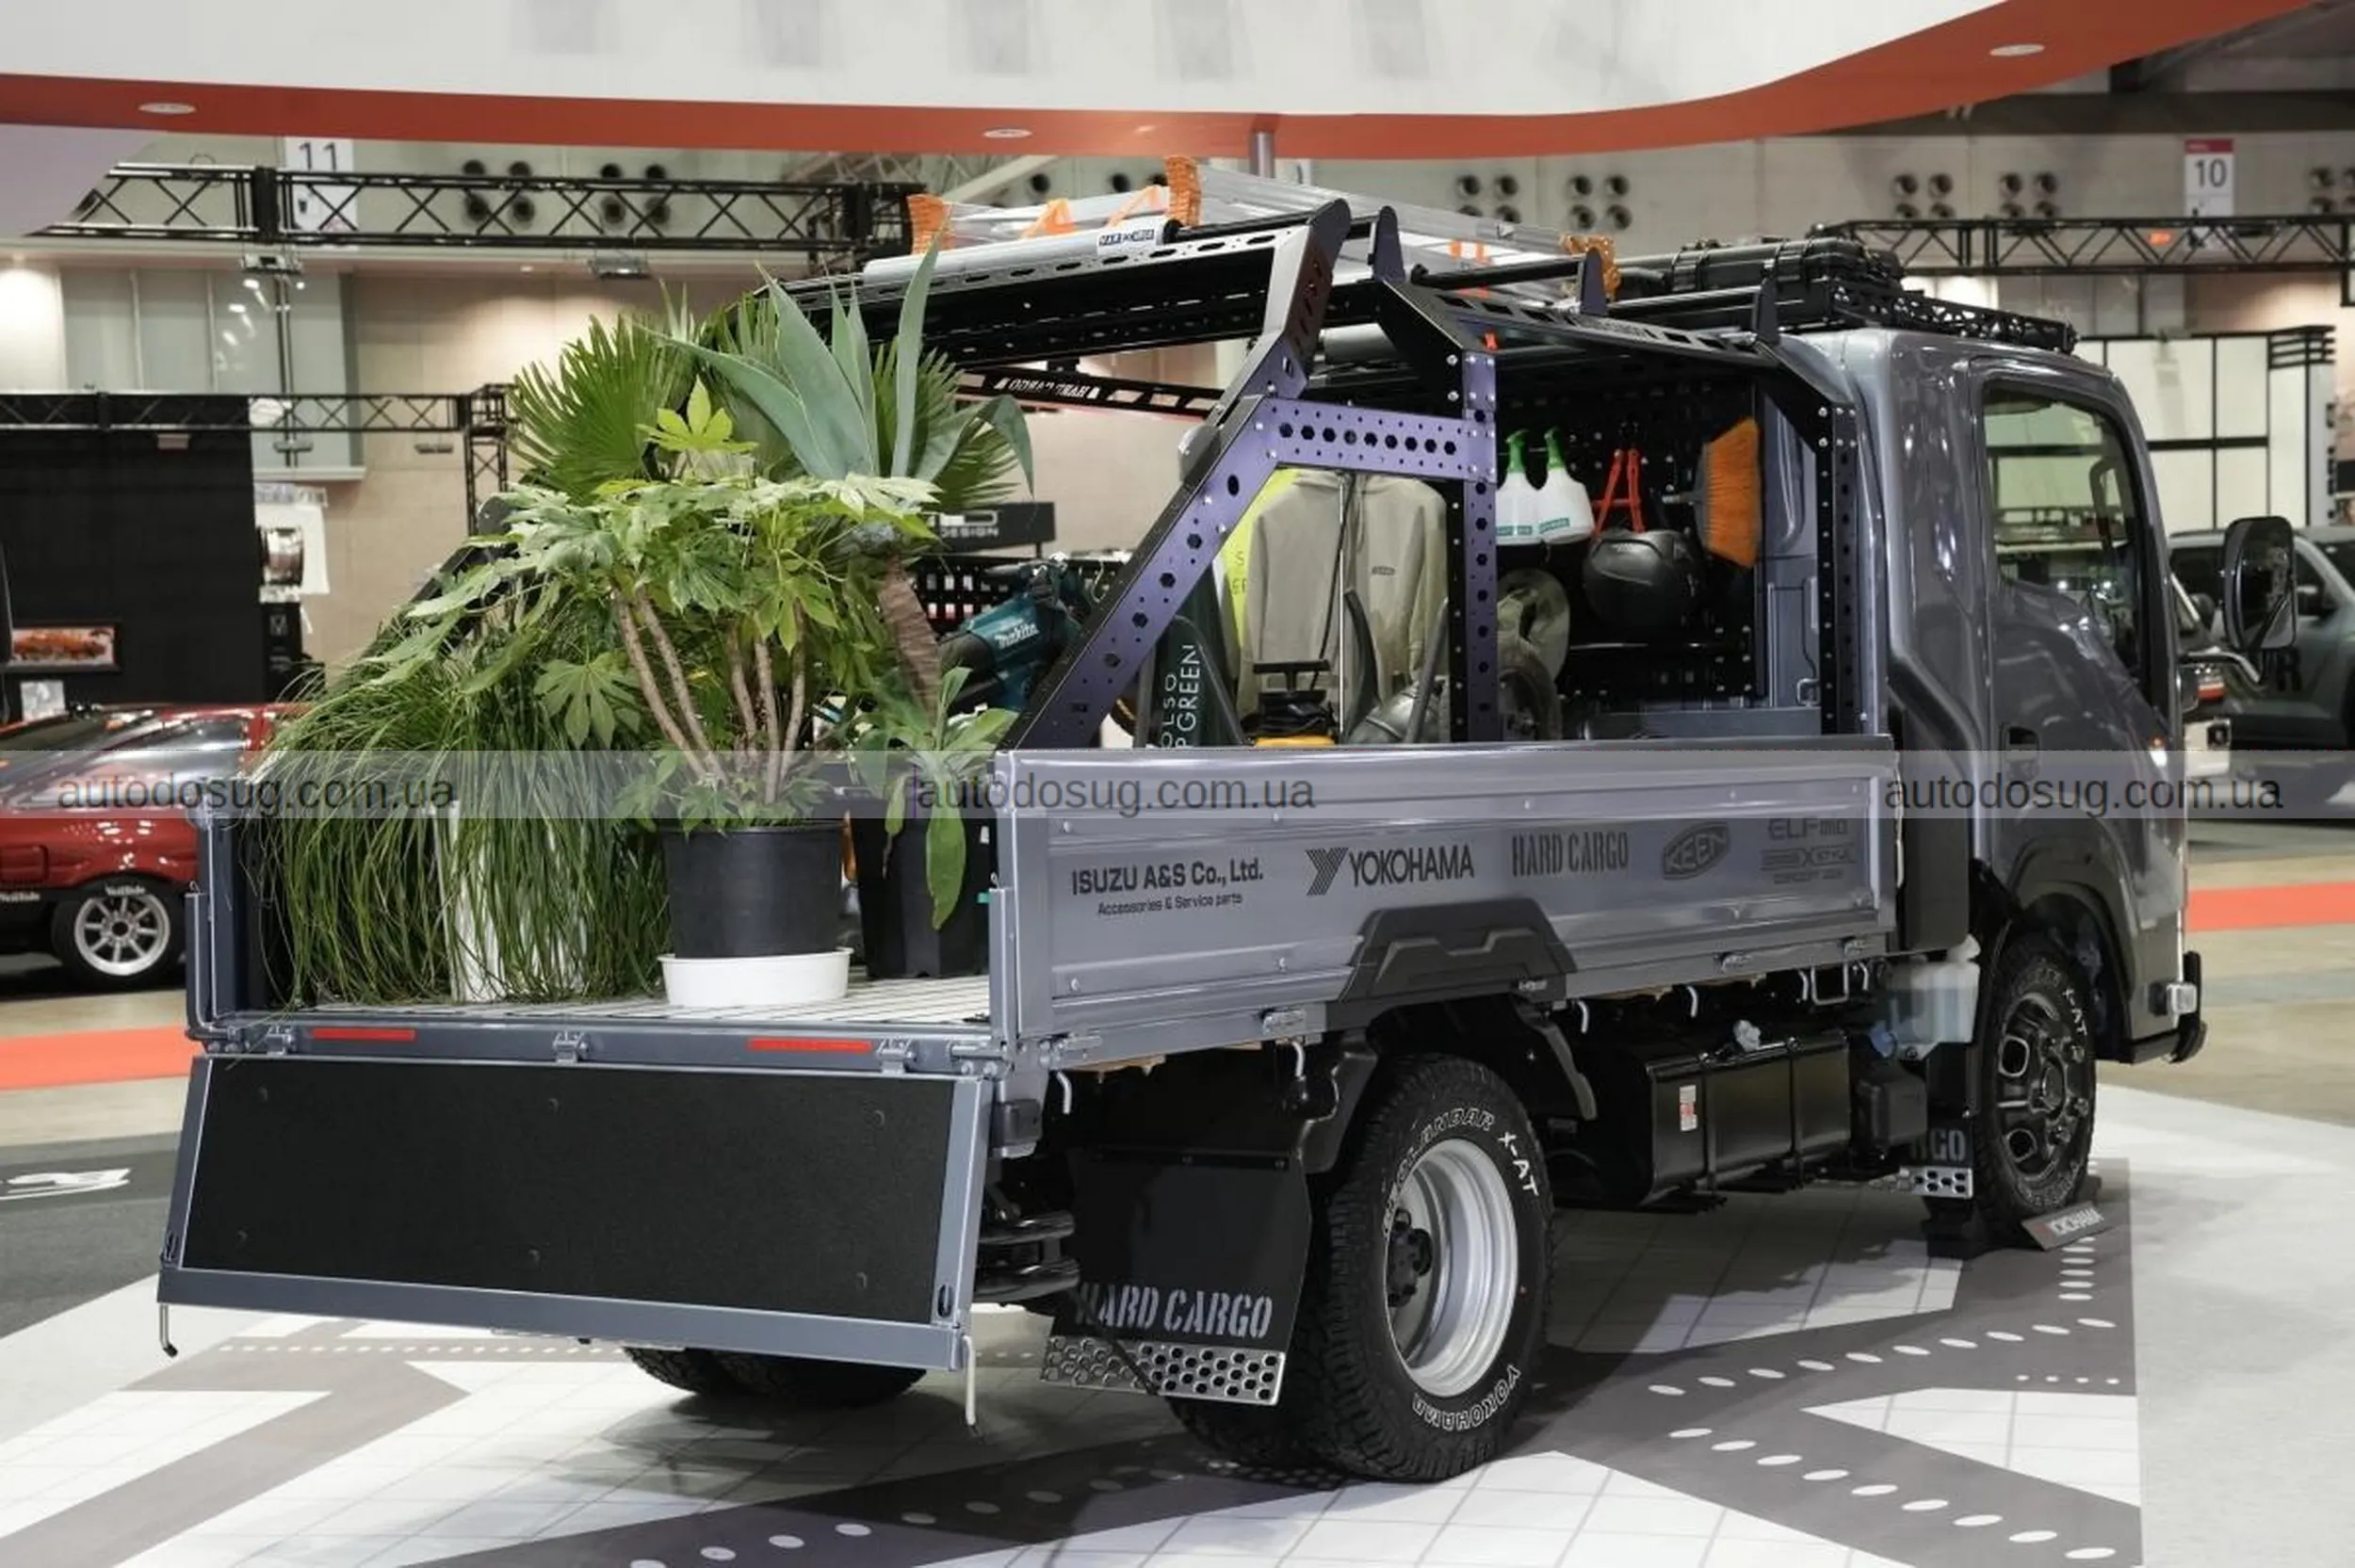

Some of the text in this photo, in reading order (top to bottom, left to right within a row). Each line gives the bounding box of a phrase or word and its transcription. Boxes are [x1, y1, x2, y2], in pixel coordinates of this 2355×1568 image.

[299, 141, 337, 172] 11
[2193, 157, 2228, 188] 10
[1072, 857, 1264, 896] ISUZU A&S Co., Ltd.
[1348, 844, 1475, 888] YOKOHAMA
[1511, 831, 1630, 878] HARD CARGO
[1097, 899, 1162, 915] Accessories
[1175, 895, 1213, 910] Service
[1215, 893, 1243, 908] parts
[1498, 1131, 1540, 1197] X-AT
[1162, 1287, 1274, 1340] CARGO
[1412, 1363, 1522, 1431] YOKOHAMA
